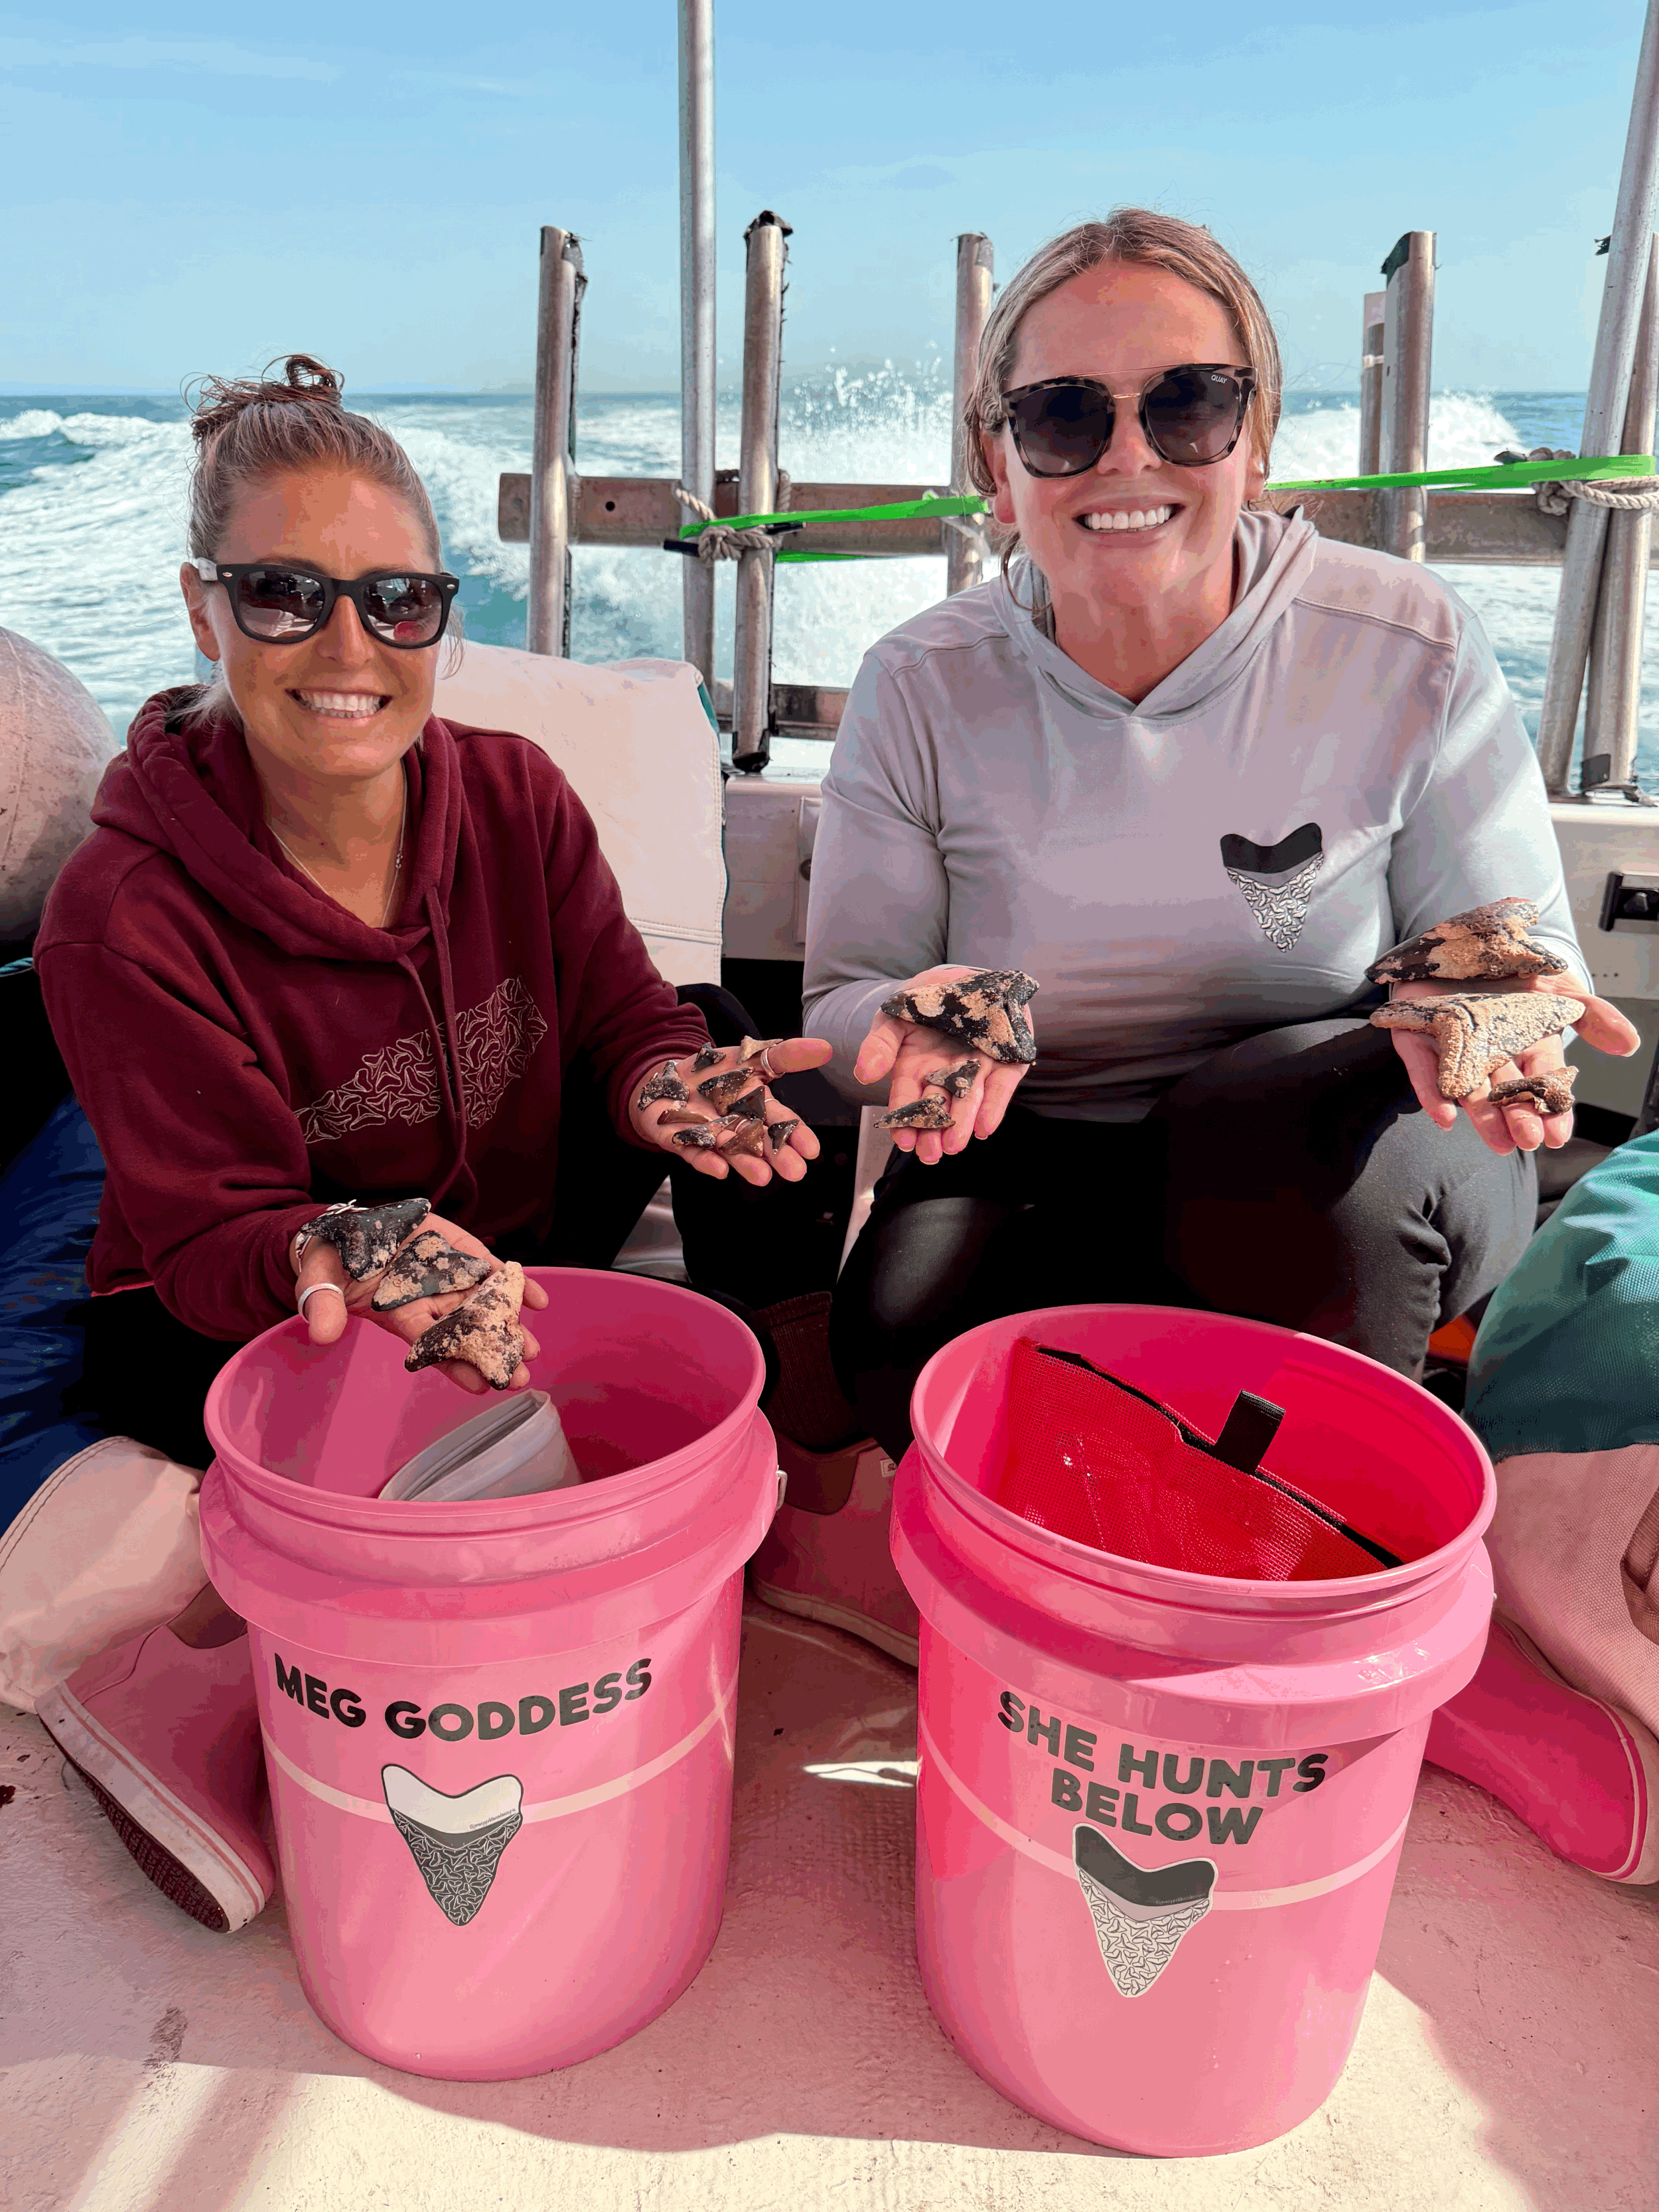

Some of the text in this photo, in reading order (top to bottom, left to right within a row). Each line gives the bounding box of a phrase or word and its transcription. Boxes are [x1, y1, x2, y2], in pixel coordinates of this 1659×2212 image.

[1211, 374, 1228, 384] QUAY
[274, 1653, 652, 1742] MEG GODDESS
[997, 1691, 1329, 1799] SHE HUNTS
[1051, 1768, 1263, 1845] BELOW
